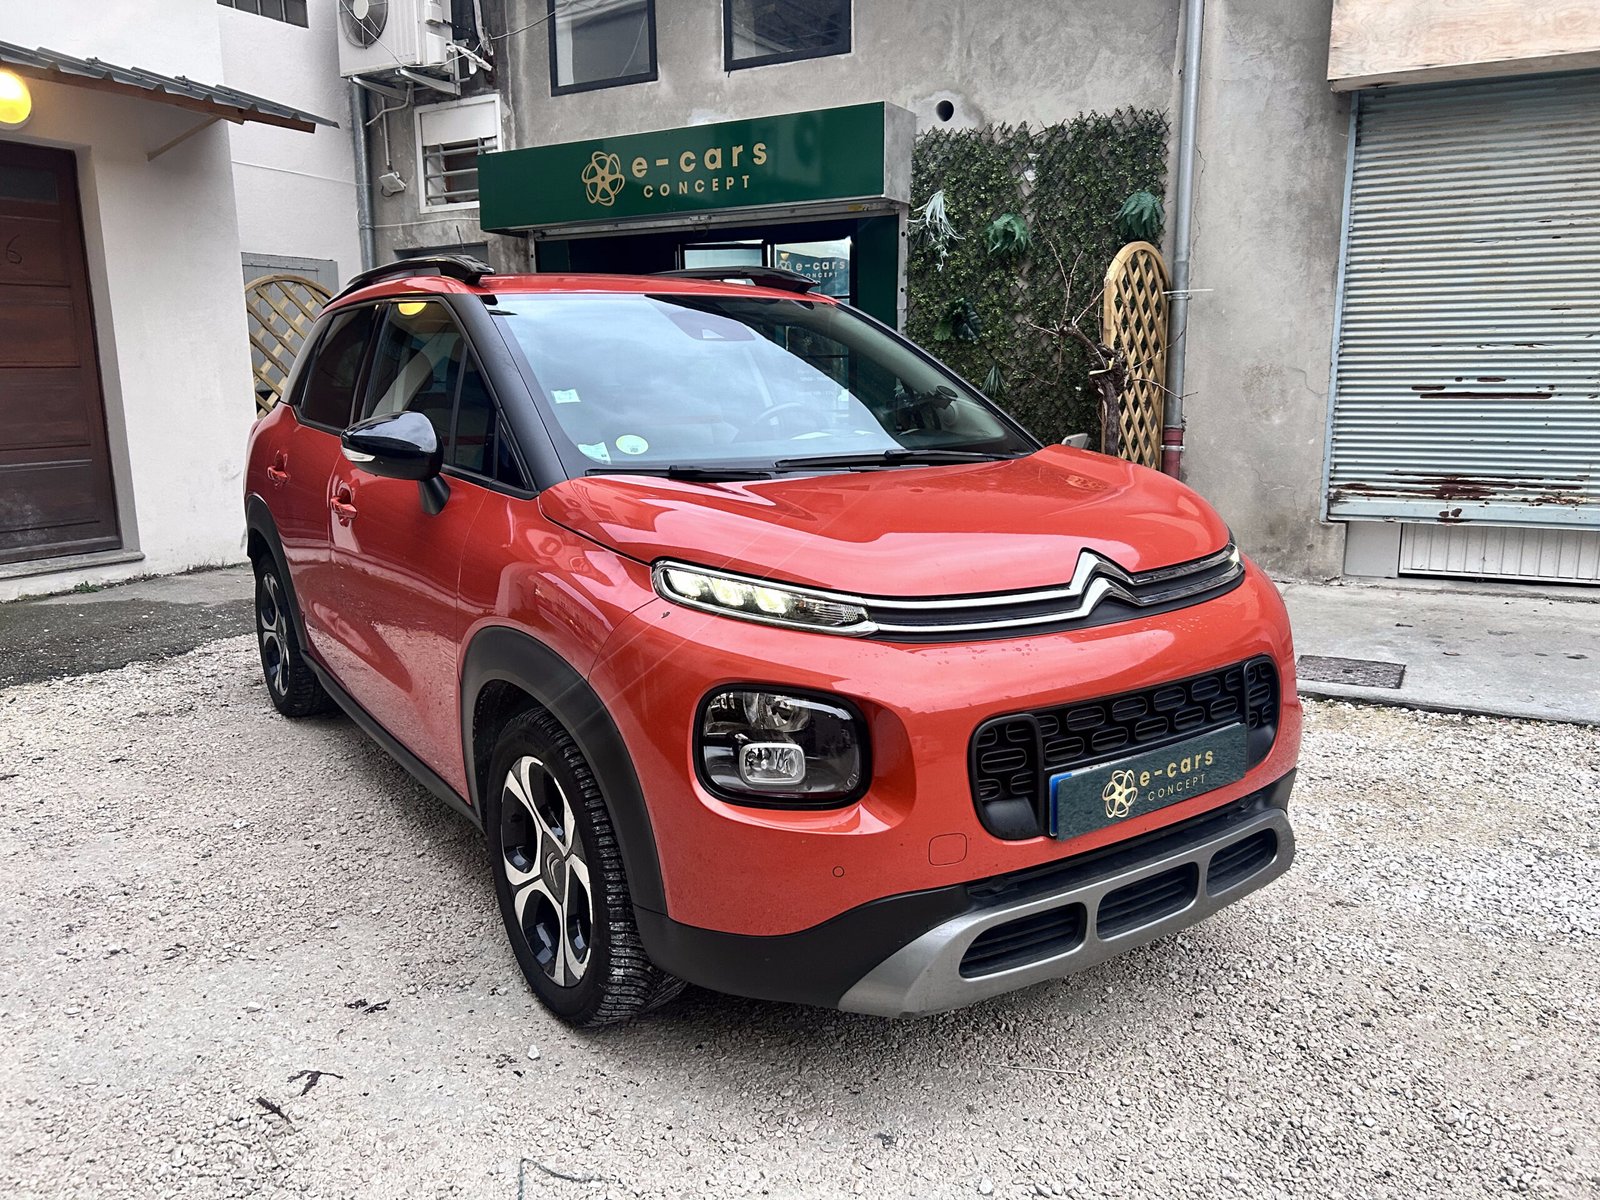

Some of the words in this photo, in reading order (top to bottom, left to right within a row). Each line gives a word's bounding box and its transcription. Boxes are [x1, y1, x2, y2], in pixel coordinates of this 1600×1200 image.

[631, 141, 768, 178] e-cars
[643, 174, 751, 198] CONCEPT
[795, 260, 846, 271] e-cars
[1139, 750, 1214, 787] e-cars
[1148, 773, 1207, 801] CONCEPT
